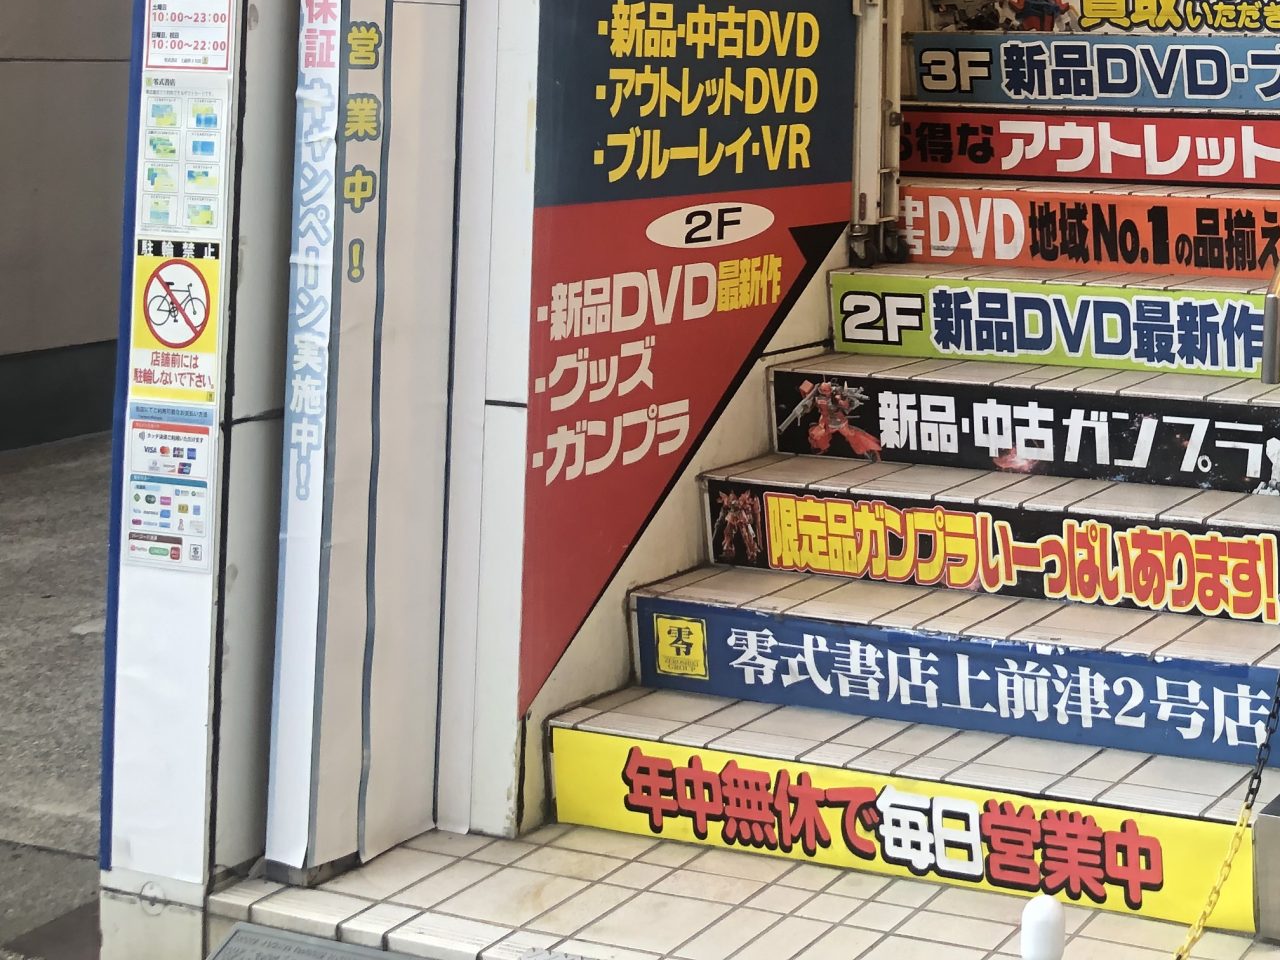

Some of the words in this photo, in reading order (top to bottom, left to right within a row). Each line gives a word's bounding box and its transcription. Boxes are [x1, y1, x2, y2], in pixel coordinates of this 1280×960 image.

[919, 48, 994, 94] 3F
[683, 206, 743, 244] 2F
[141, 240, 216, 259] 駐輪禁止
[840, 290, 926, 345] 2F
[133, 367, 215, 389] 駐輪しないで下さい。
[150, 351, 199, 368] 店舗前には
[725, 625, 1274, 749] 零式書店上前津2号店
[622, 746, 1163, 909] 年中無休で毎日営業中
